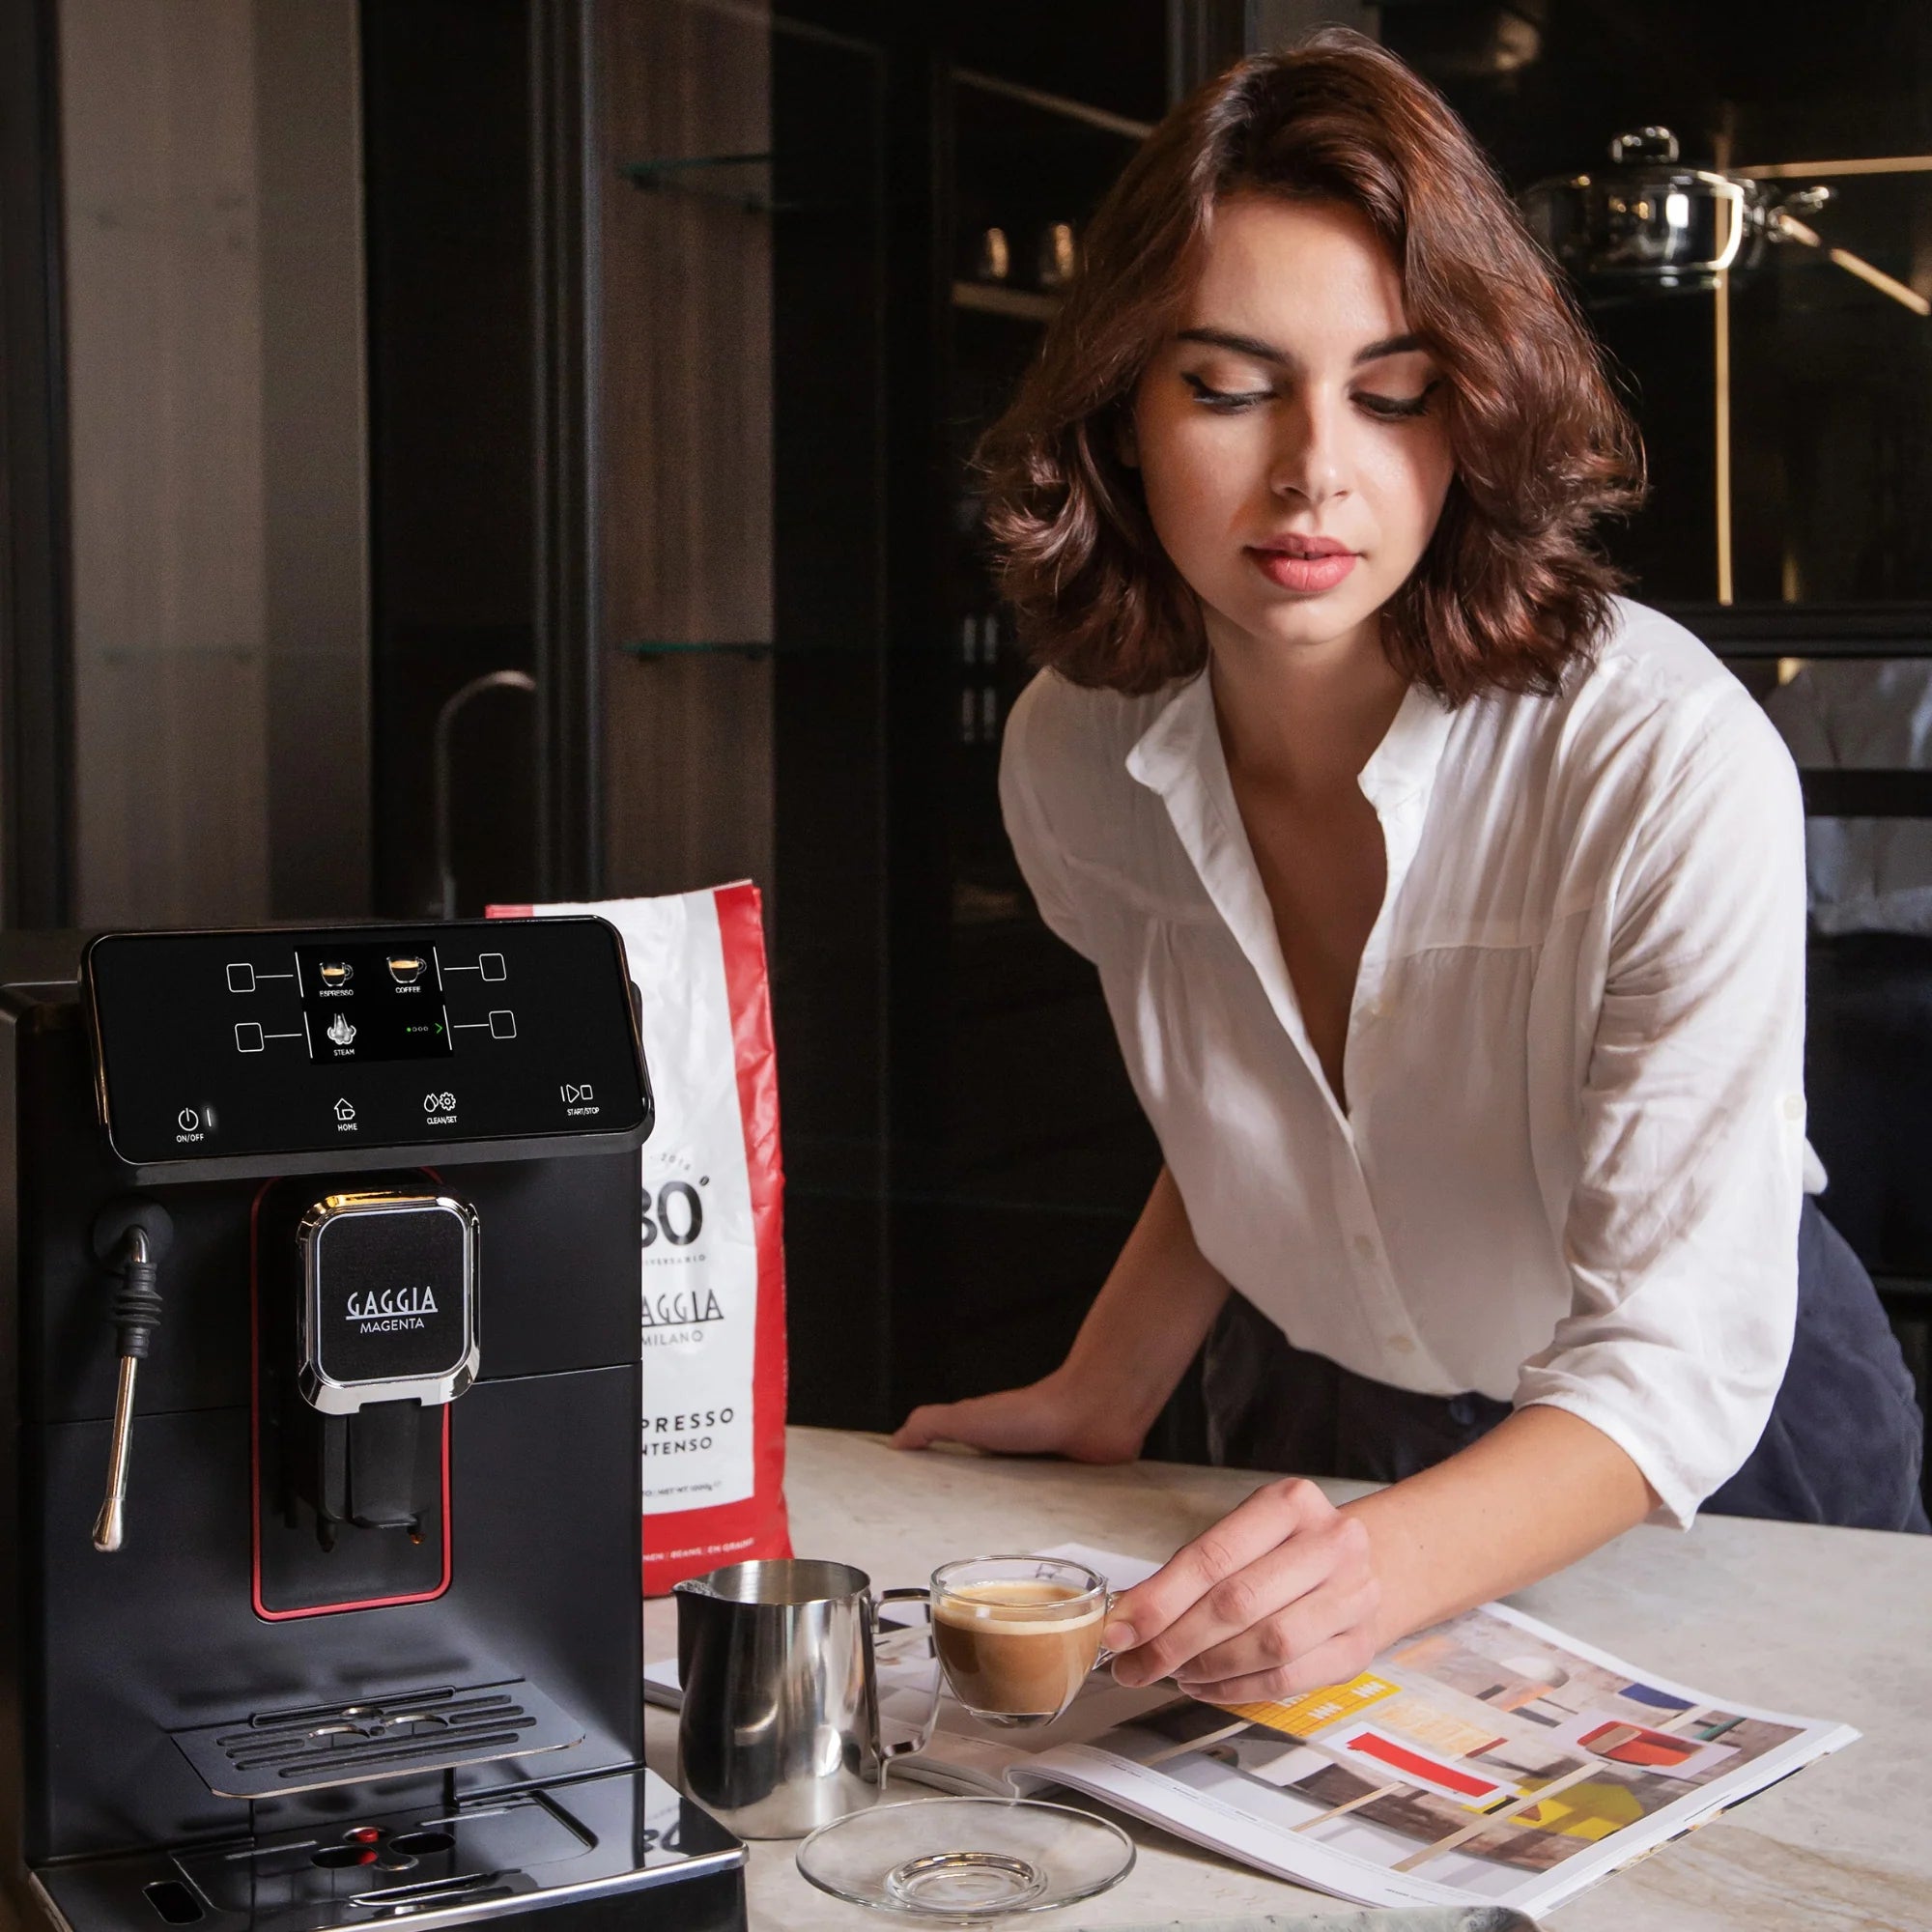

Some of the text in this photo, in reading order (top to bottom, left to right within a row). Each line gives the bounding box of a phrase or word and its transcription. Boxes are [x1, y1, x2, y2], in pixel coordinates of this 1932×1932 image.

[395, 985, 421, 994] COFFEE
[333, 1048, 355, 1057] STEAM
[567, 1107, 600, 1116] START/STOP
[426, 1115, 457, 1125] CLEAN/SET
[337, 1122, 358, 1131] HOME
[176, 1133, 205, 1143] ON/OFF
[346, 1286, 439, 1321] GAGGIA
[360, 1318, 425, 1334] MAGENTA
[641, 1329, 704, 1347] MILANO
